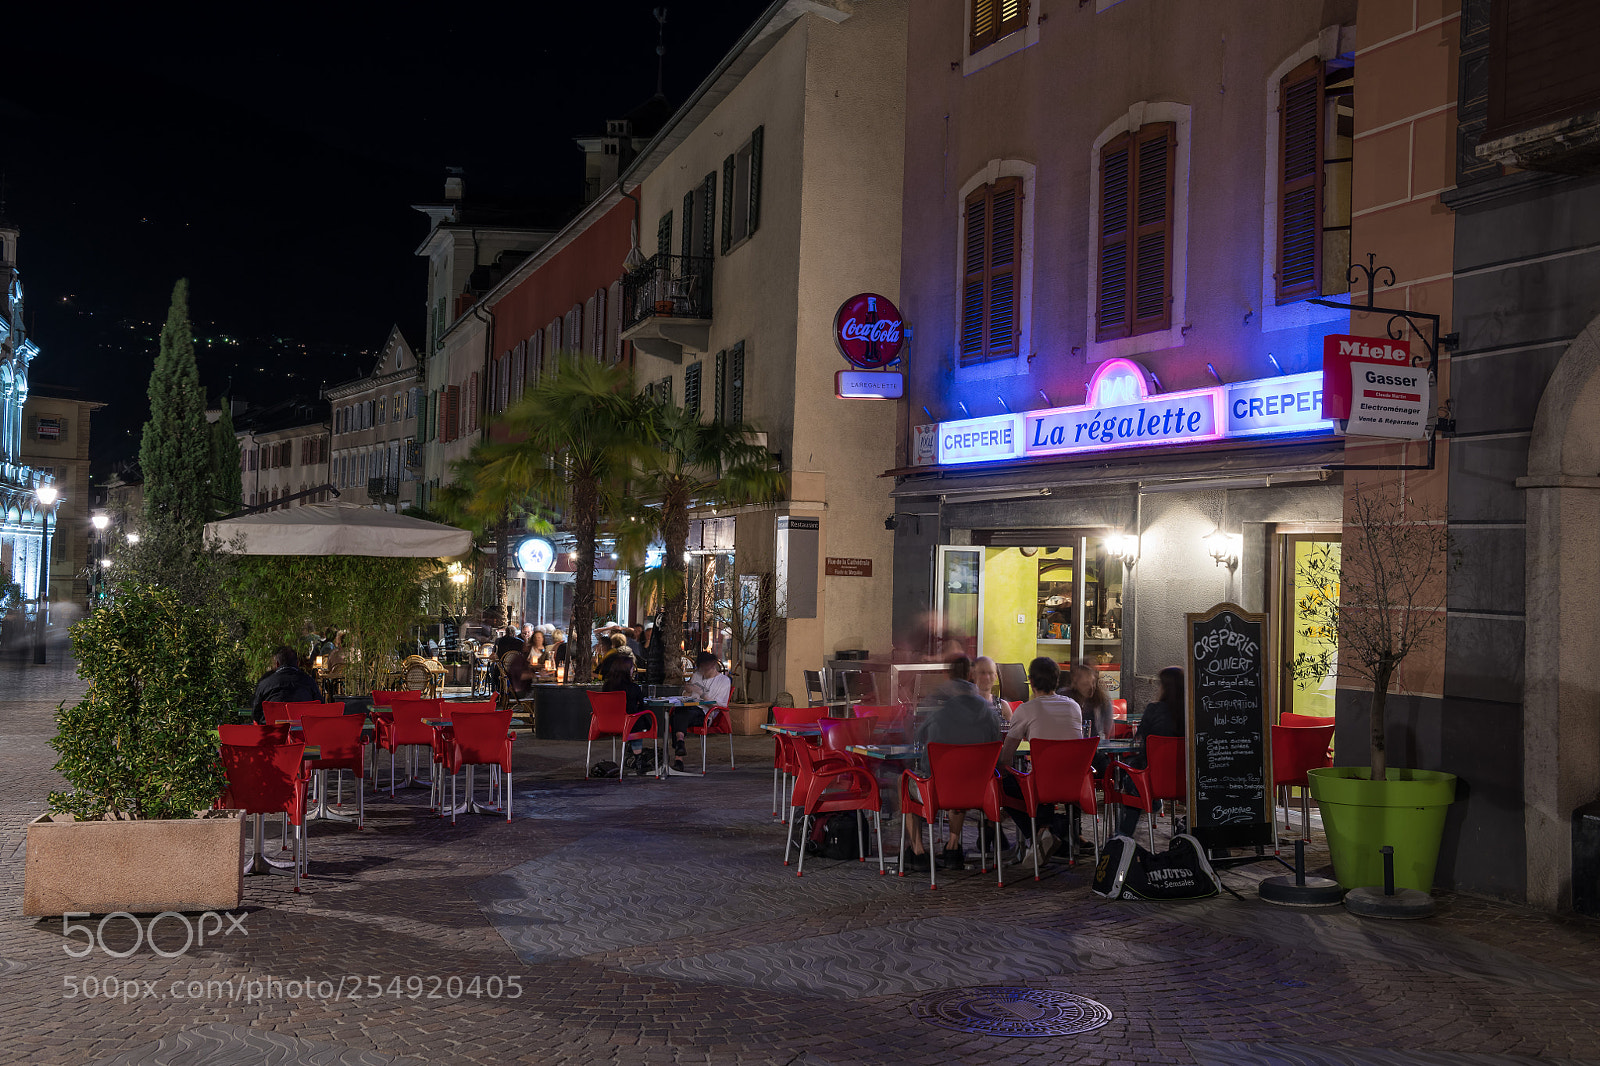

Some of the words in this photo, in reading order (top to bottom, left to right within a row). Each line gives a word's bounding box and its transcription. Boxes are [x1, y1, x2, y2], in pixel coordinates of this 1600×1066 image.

[842, 318, 901, 342] Coca-Cola
[1339, 341, 1406, 361] Miele
[1366, 371, 1418, 387] Gasser
[1100, 375, 1136, 405] BAR
[1360, 403, 1421, 415] Electroménager
[1032, 418, 1065, 447] La
[1074, 407, 1201, 443] régalette
[1358, 416, 1377, 424] Vente
[1385, 418, 1419, 427] Réparation
[944, 428, 1012, 450] CREPERIE
[1208, 657, 1253, 672] OUVERT
